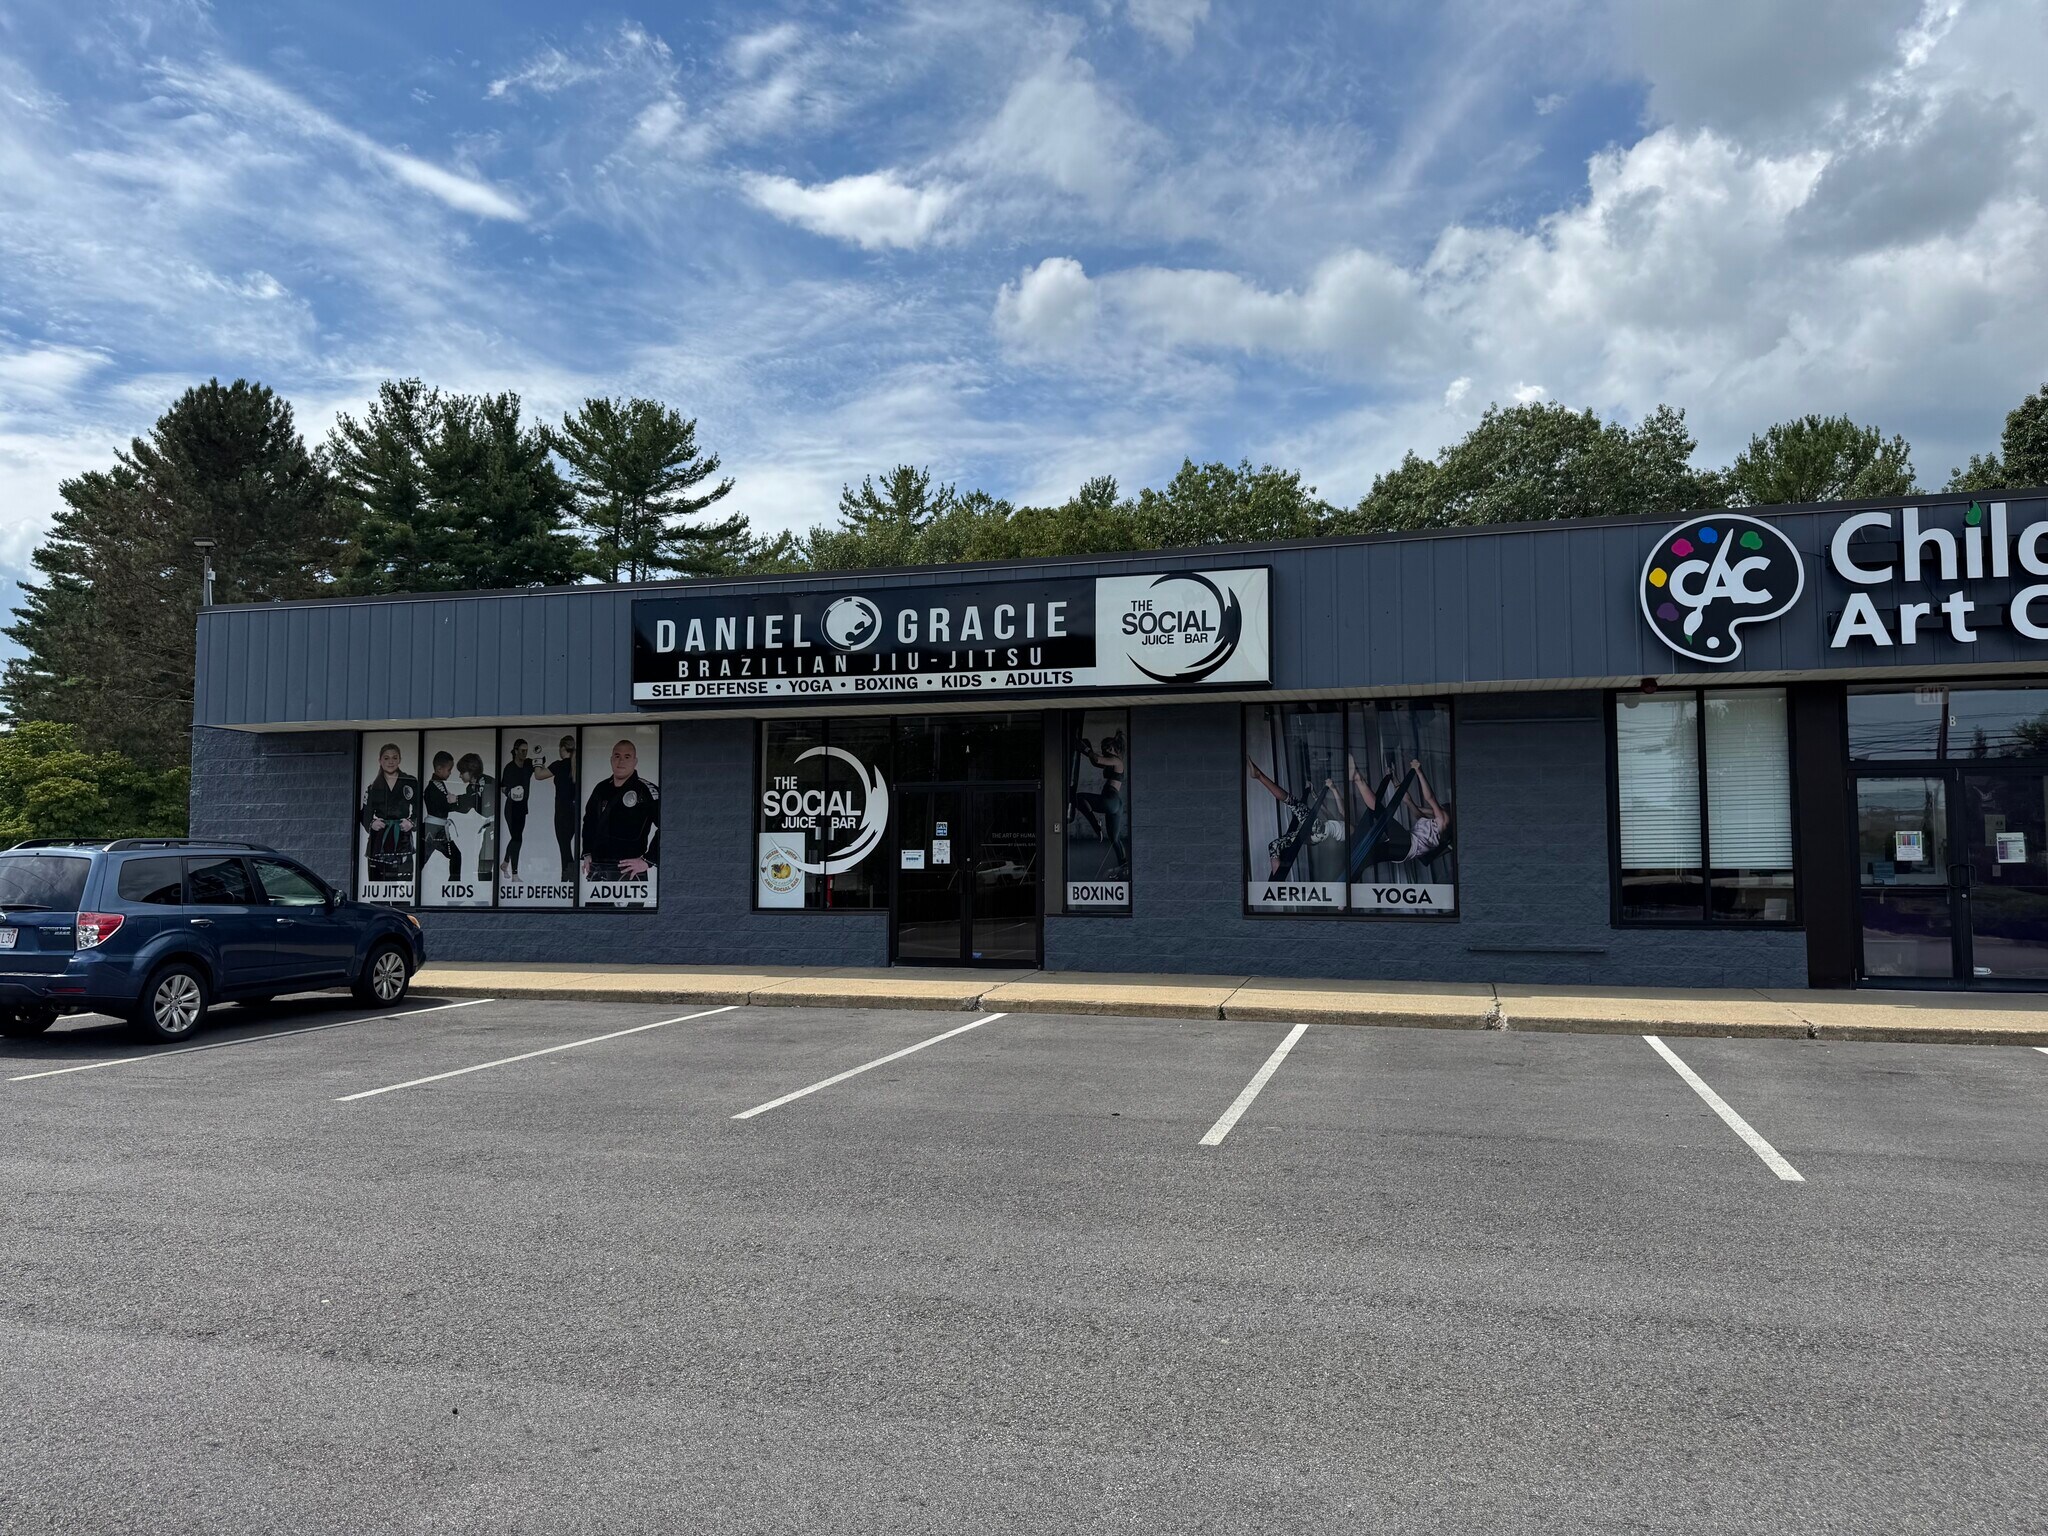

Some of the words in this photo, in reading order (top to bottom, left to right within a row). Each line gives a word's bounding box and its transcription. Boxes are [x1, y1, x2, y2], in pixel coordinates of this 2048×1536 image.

[1131, 600, 1152, 611] THE
[656, 614, 811, 653] DANIEL
[898, 601, 1067, 644] GRACIE
[1122, 610, 1216, 635] SOCIAL
[1830, 591, 1977, 648] Art
[1142, 634, 1174, 645] JUICE
[1184, 633, 1208, 644] BAR
[678, 655, 847, 678] BRAZILIAN
[873, 647, 1041, 671] JIU-JITSU
[652, 683, 690, 697] SELF
[695, 681, 768, 695] DEFENSE
[788, 679, 832, 693] YOGA
[855, 676, 918, 691] BOXING
[942, 674, 982, 688] KIDS
[1005, 671, 1073, 686] ADULTS
[774, 776, 797, 789] THE
[763, 790, 861, 816] SOCIAL
[781, 817, 816, 828] JUICE
[831, 817, 856, 828] BAR
[362, 885, 379, 898] JIU
[383, 885, 414, 898] JITSU
[441, 885, 474, 898] KIDS
[500, 886, 524, 899] SELF
[527, 886, 574, 899] DEFENSE
[590, 885, 648, 899] ADULTS
[1072, 886, 1124, 901] BOXING
[1262, 887, 1332, 902] AERIAL
[1372, 888, 1432, 904] YOGA
